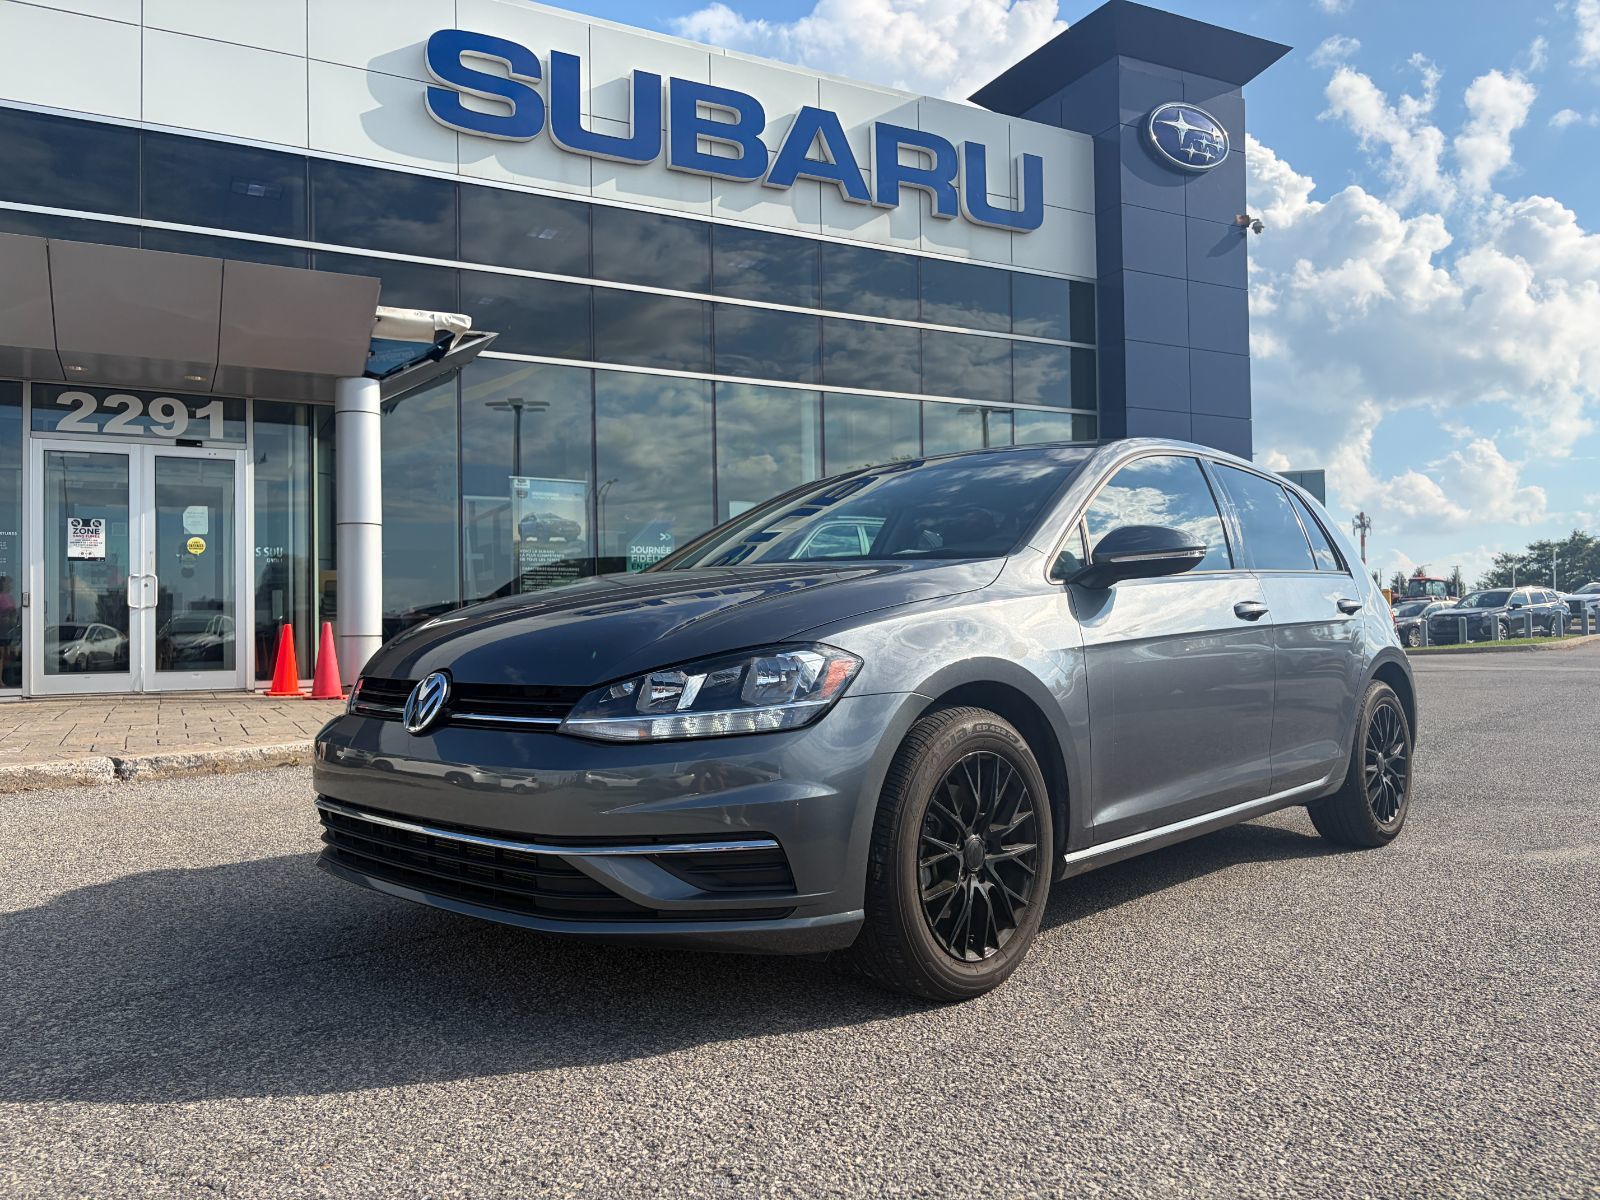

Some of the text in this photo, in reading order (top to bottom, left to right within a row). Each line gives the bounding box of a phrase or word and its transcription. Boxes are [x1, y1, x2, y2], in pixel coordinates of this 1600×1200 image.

[424, 29, 1043, 233] SUBARU
[56, 391, 224, 440] 2291
[630, 545, 672, 555] JOURNÉE
